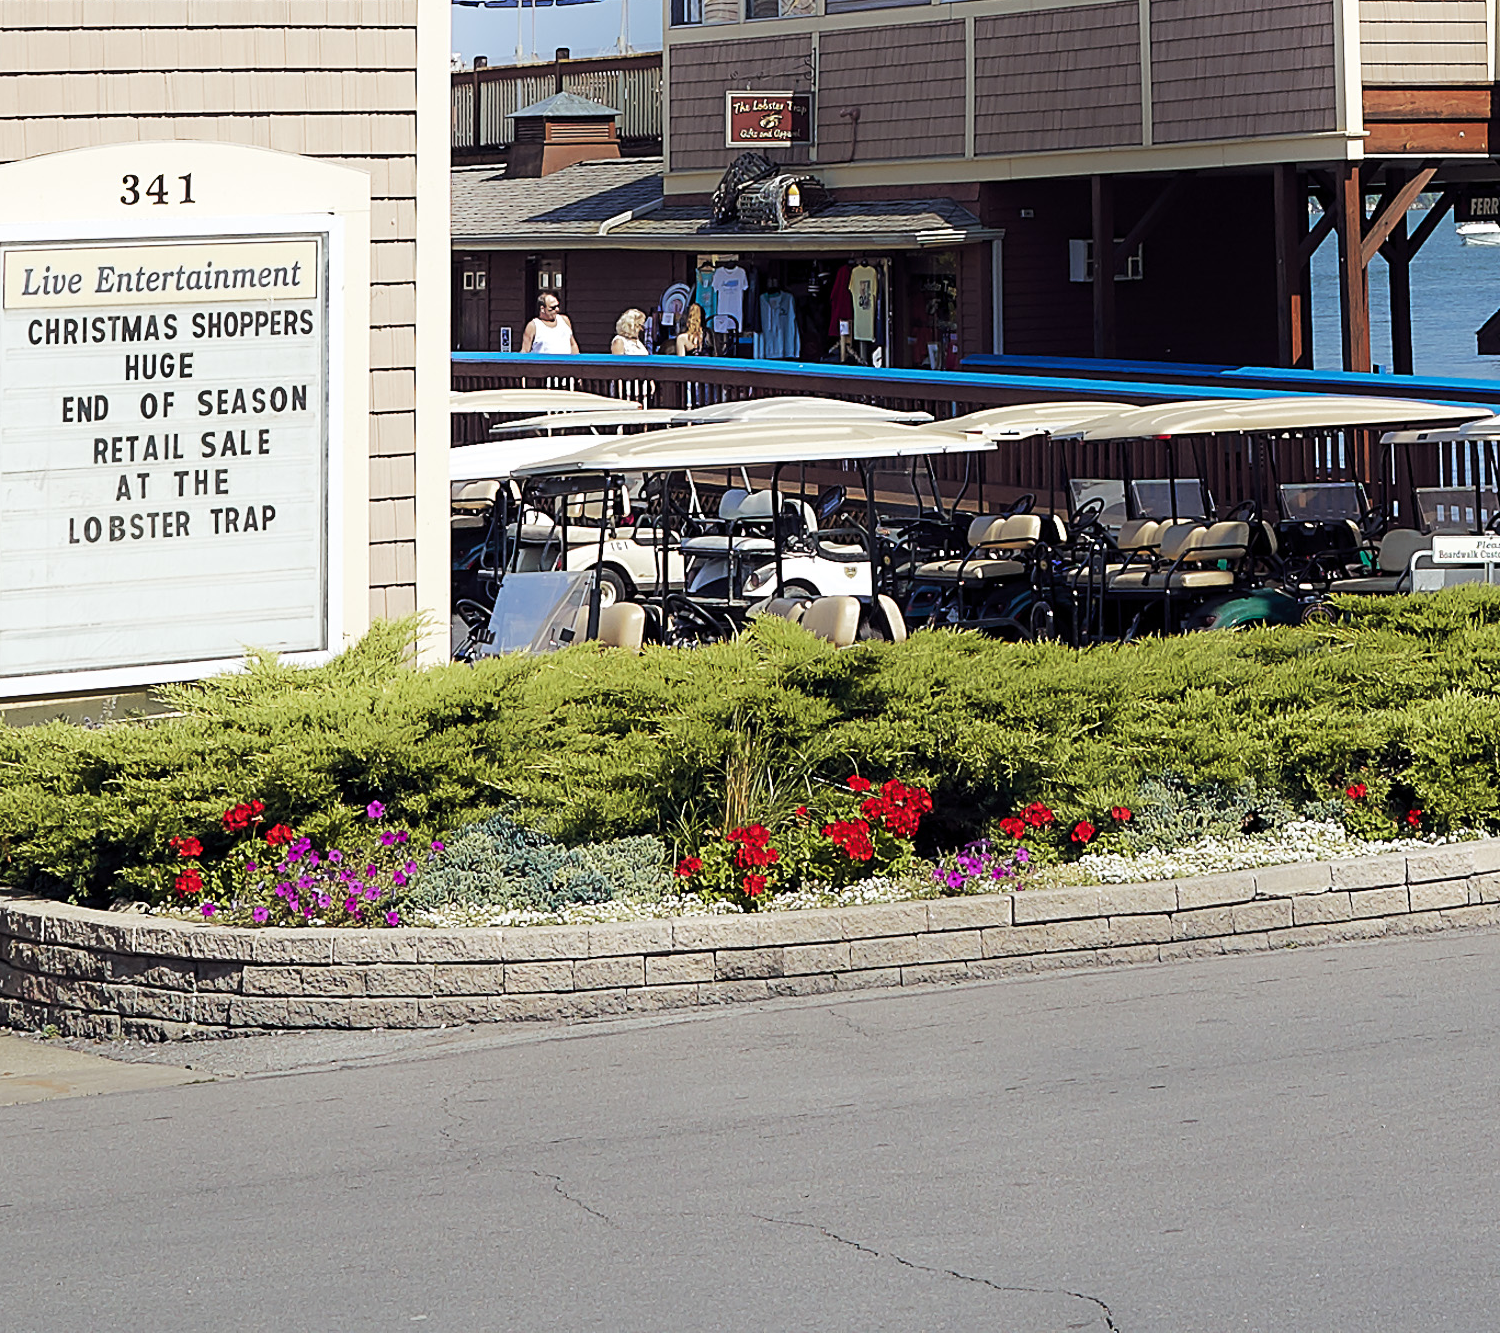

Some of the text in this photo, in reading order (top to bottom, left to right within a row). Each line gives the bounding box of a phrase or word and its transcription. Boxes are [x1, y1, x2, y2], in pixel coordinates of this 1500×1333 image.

[733, 100, 751, 115] The
[752, 98, 785, 112] Lobster
[120, 172, 196, 206] 341
[21, 260, 302, 297] Live Entertainment
[28, 309, 314, 346] CHRISTMAS SHOPPERS
[125, 352, 194, 381] HUGE
[62, 384, 307, 423] END OF SEASON
[93, 428, 271, 464] RETAIL SALE
[115, 468, 229, 502] AT THE
[69, 504, 276, 544] LOBSTER TRAP
[1438, 549, 1479, 559] Boardwalk
